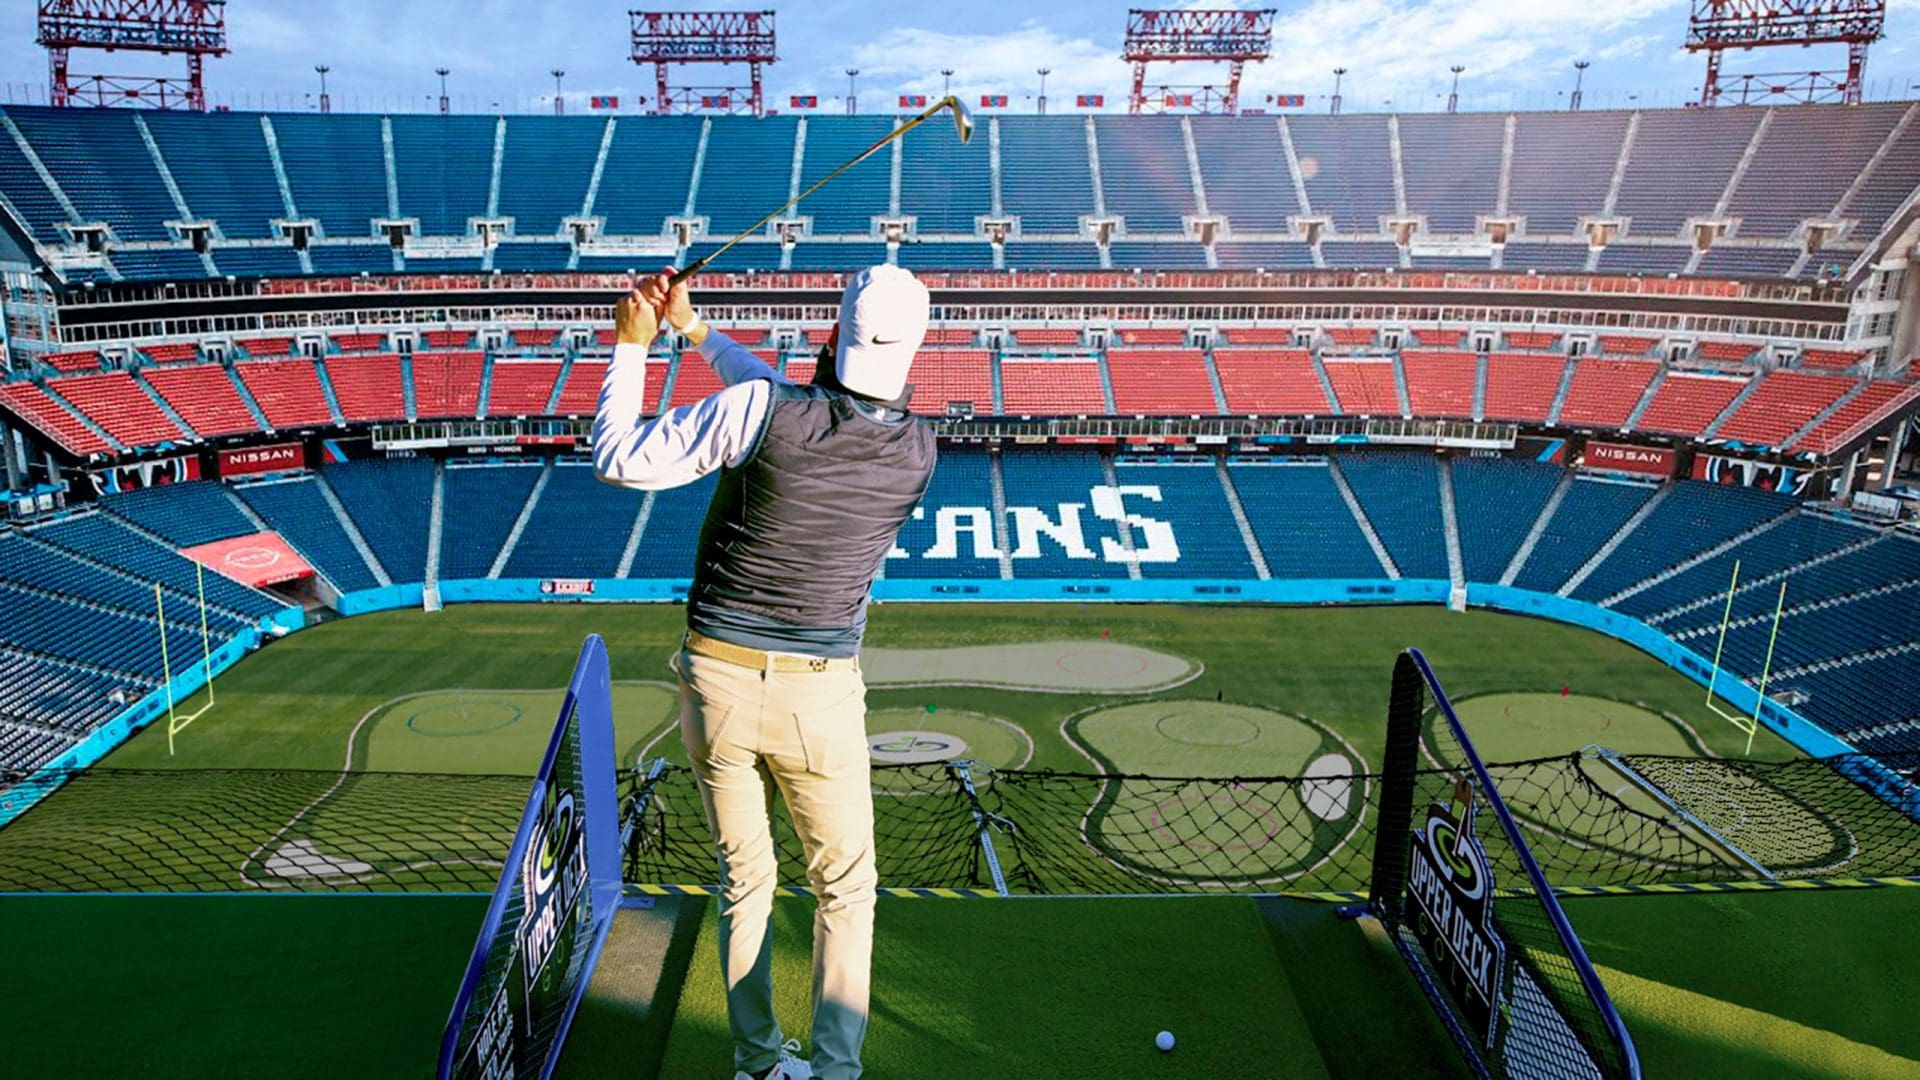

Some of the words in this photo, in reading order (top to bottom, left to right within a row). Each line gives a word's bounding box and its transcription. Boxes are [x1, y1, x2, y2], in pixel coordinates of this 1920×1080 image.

[229, 449, 294, 464] NISSAN
[1594, 448, 1662, 463] NISSAN
[528, 882, 563, 979] UPPER
[1411, 844, 1452, 936] UPPER
[1453, 905, 1492, 994] DECK
[1418, 911, 1473, 1003] GOLF
